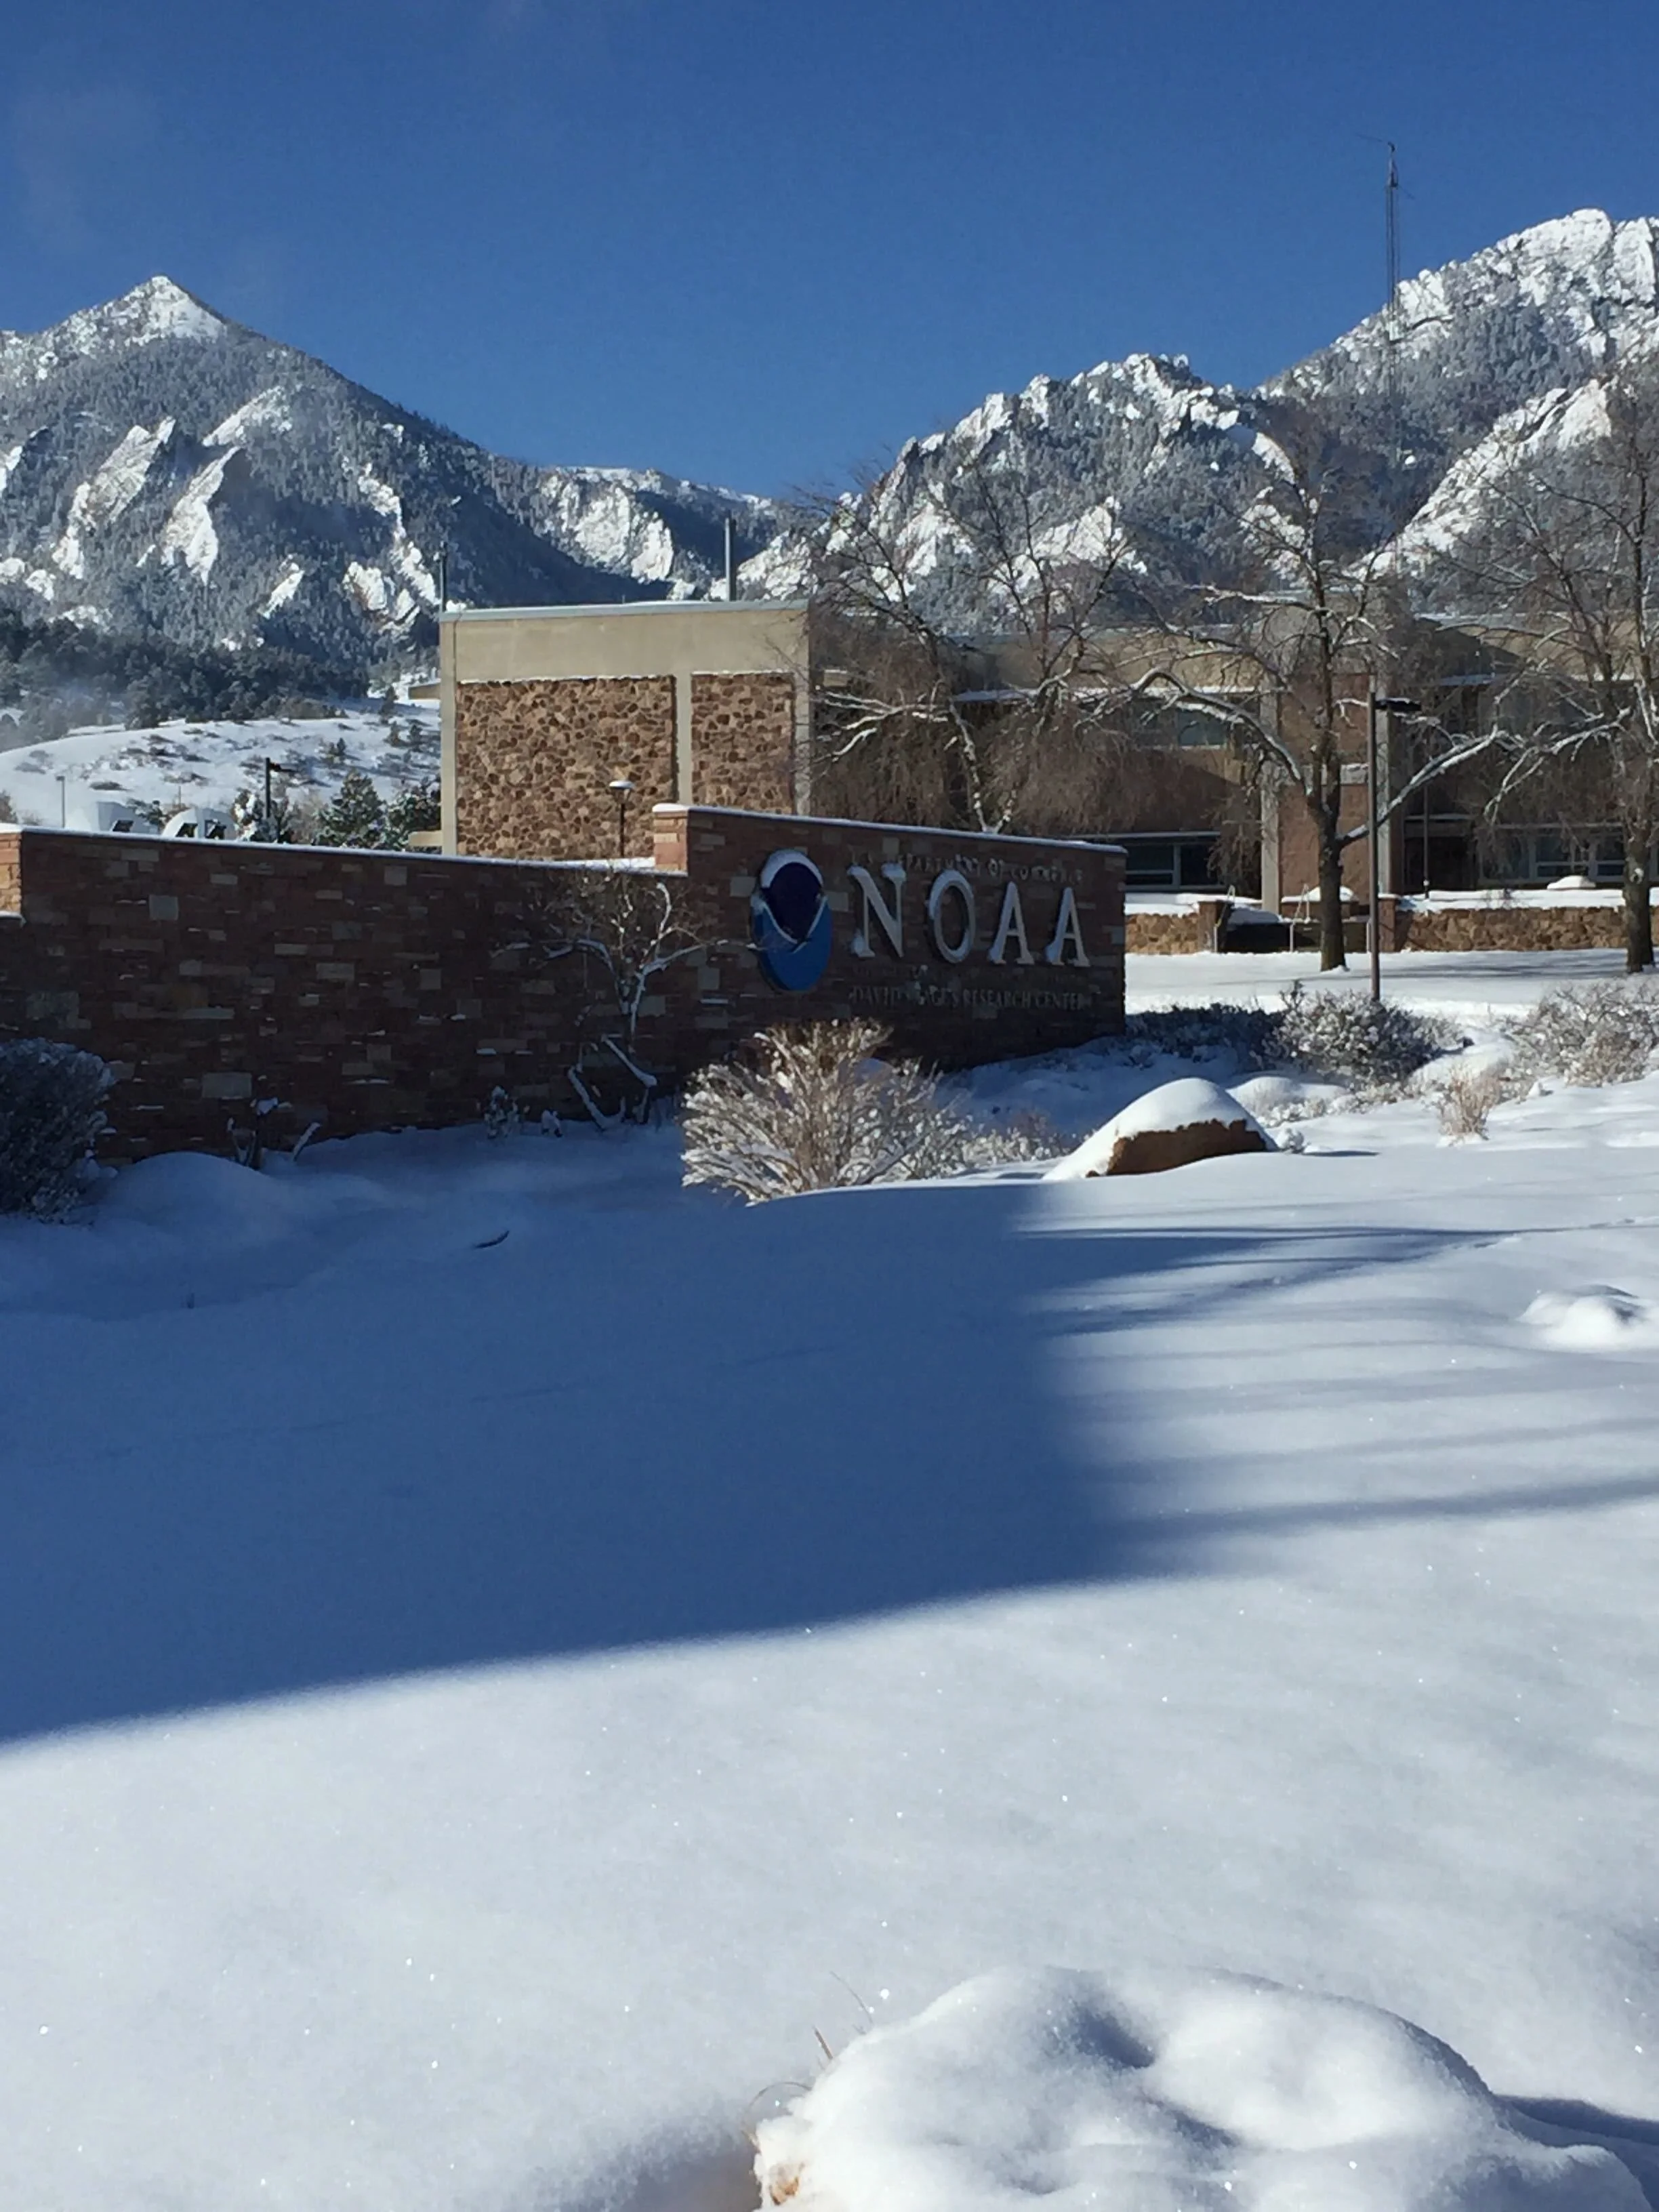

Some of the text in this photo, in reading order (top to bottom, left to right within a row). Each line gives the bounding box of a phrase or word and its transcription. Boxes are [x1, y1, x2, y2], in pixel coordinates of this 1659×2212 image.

[848, 863, 1090, 967] NOAA
[962, 989, 1031, 1008] RESEARCH
[1034, 991, 1084, 1011] CENTER
